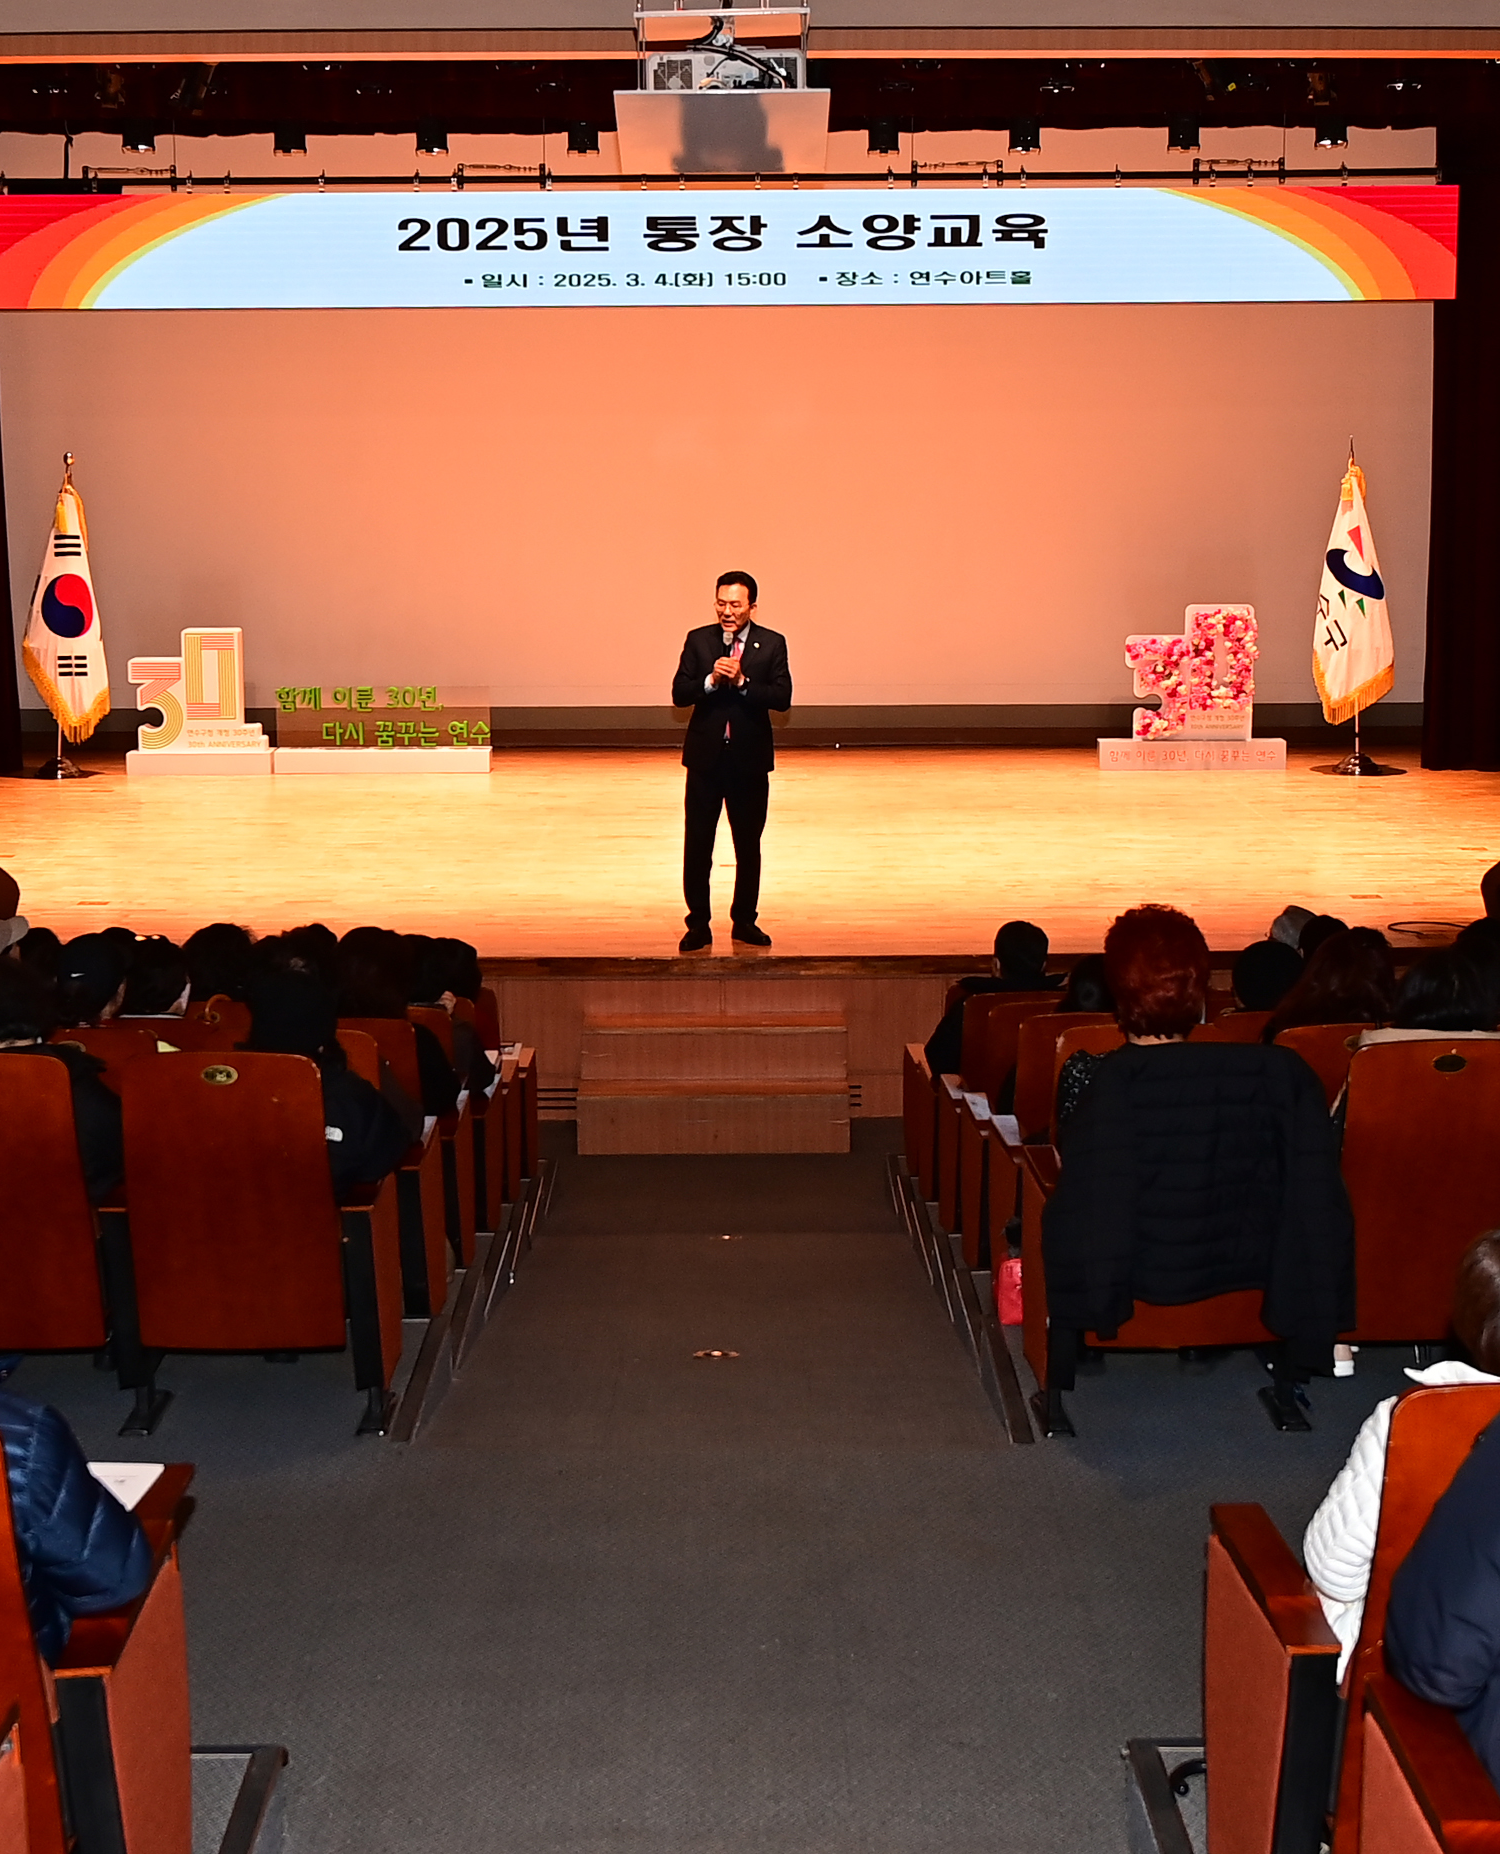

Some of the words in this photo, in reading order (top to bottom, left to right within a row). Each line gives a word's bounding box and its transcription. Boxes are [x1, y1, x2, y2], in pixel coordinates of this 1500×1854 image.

[397, 215, 610, 252] 2025년
[642, 214, 769, 252] 통장
[796, 213, 1049, 251] 소양교육
[482, 273, 528, 288] 일시
[553, 272, 618, 288] 2025.
[625, 273, 645, 287] 3.
[724, 271, 787, 287] 15:00
[835, 271, 884, 286] 장소
[909, 270, 1032, 286] 연수아트홀
[130, 632, 237, 750] 30
[275, 686, 322, 712] 함께
[332, 686, 376, 712] 이룬
[385, 685, 445, 712] 30년,
[322, 721, 364, 746] 다시
[374, 721, 440, 747] 꿈꾸는
[448, 719, 492, 746] 연수
[208, 740, 262, 749] ANNIVERSARY
[1255, 750, 1278, 761] 연수
